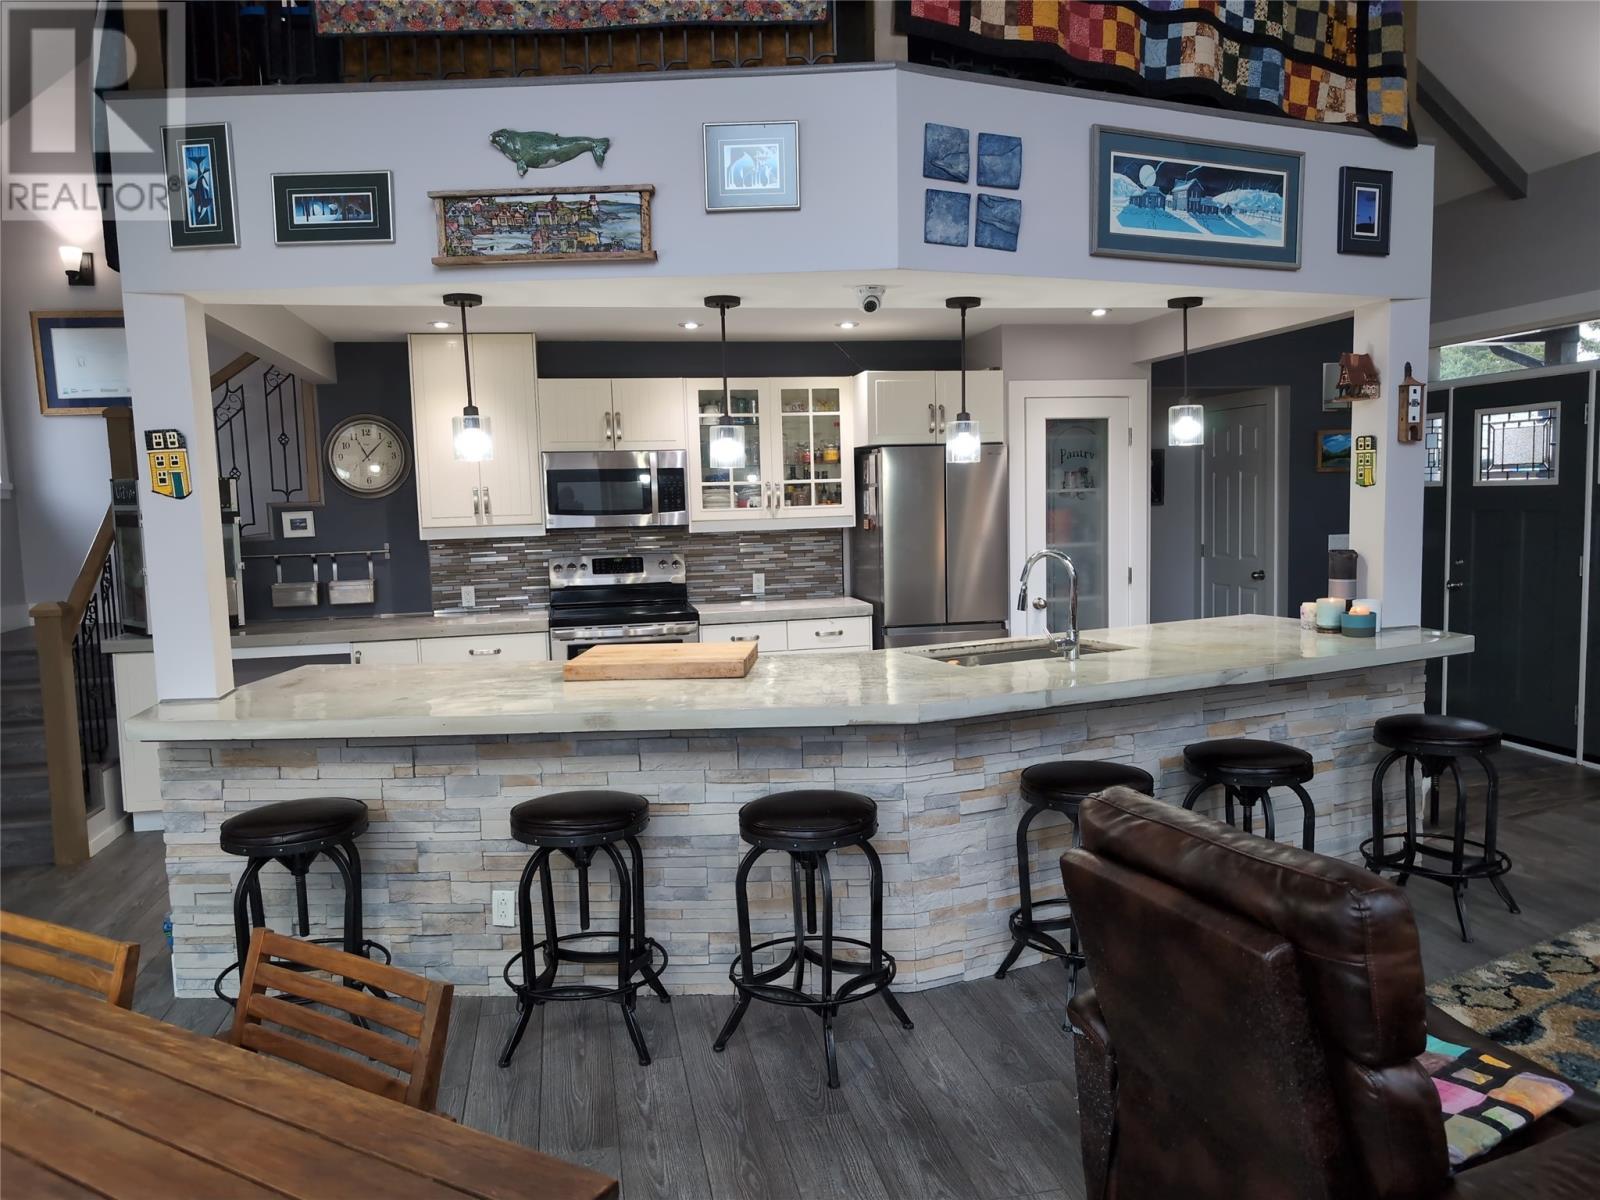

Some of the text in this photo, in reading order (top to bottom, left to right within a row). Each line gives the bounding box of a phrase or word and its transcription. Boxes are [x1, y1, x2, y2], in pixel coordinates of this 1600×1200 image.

[350, 432, 358, 441] 11
[362, 429, 370, 437] 12
[342, 441, 351, 450] 10
[386, 440, 392, 448] 2
[1060, 448, 1096, 464] Pantry
[366, 476, 372, 484] 6
